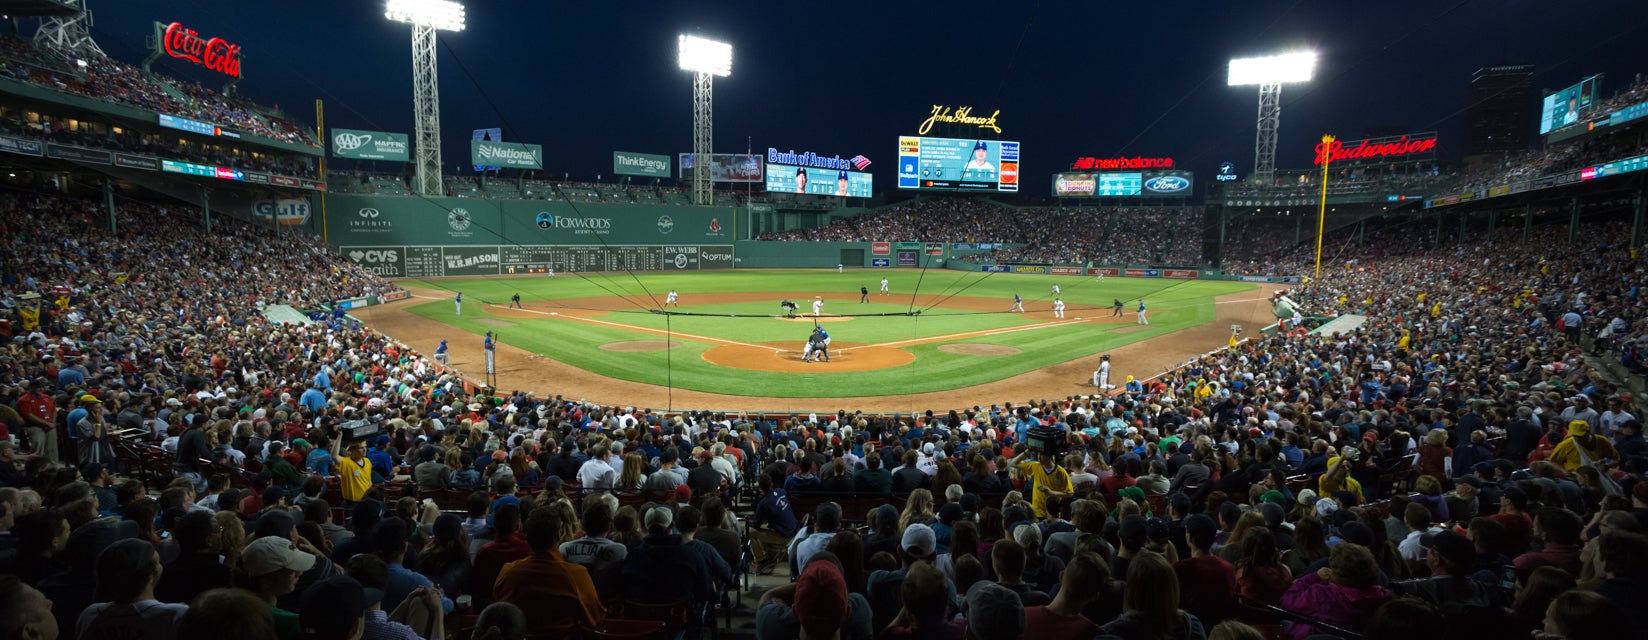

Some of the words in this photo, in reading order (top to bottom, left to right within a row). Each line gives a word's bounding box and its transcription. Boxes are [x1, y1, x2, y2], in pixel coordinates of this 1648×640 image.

[203, 36, 240, 78] Cola
[918, 104, 952, 135] John
[491, 147, 536, 160] National
[1314, 136, 1437, 165] Budweiser
[617, 155, 666, 171] ThinkEnergy
[768, 147, 798, 165] Bank
[798, 151, 810, 166] of
[809, 152, 851, 170] America
[1120, 156, 1173, 169] balance
[1152, 176, 1180, 190] Ford
[1216, 174, 1238, 182] tyco
[256, 202, 306, 216] Gulf
[365, 250, 398, 262] CVS
[565, 542, 614, 562] WILLIAMS
